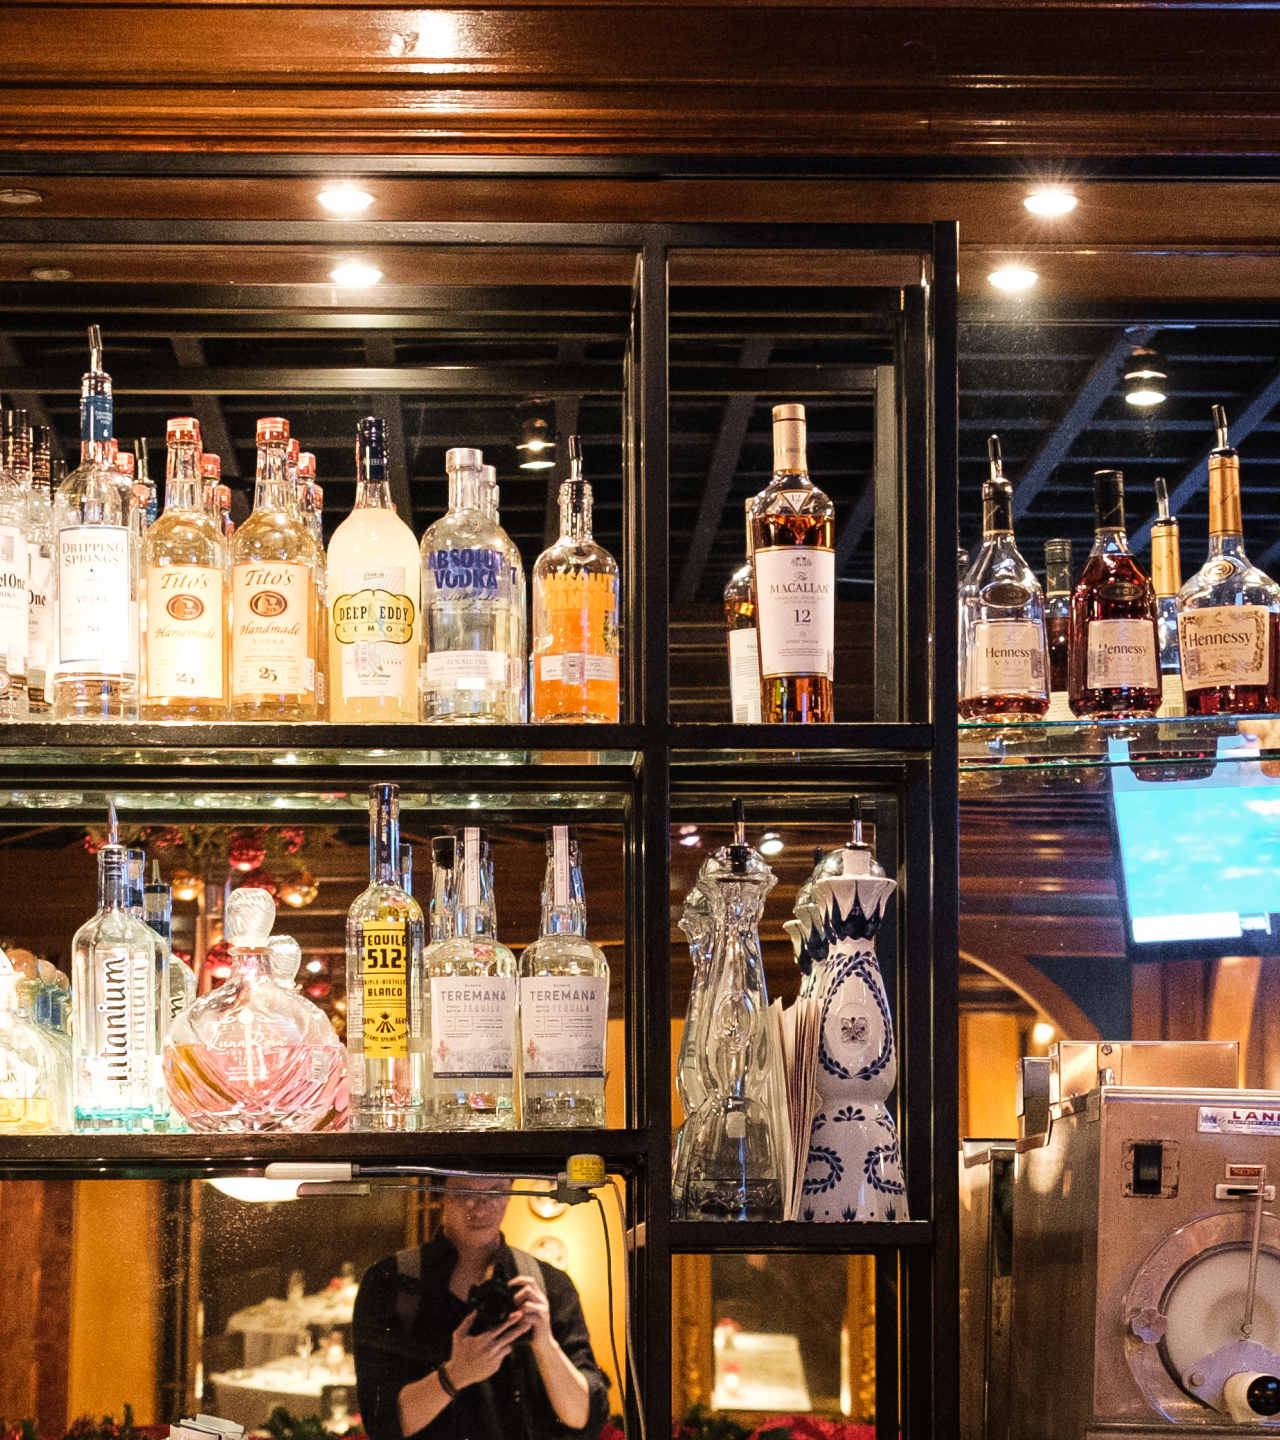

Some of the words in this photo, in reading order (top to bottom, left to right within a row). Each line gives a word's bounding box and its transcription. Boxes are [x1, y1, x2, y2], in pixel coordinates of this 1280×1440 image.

[65, 554, 119, 566] SPRINGS
[428, 549, 503, 570] ABSOLUT
[8, 578, 26, 590] One
[160, 573, 210, 590] Tito's
[244, 569, 295, 587] Tito's
[434, 568, 498, 589] VODKA
[770, 583, 830, 593] MACALLAN
[339, 607, 368, 621] DEEP
[379, 606, 409, 621] EDDY
[794, 609, 811, 623] 12
[239, 622, 301, 636] Handmade
[1186, 630, 1253, 648] Hennessy
[985, 646, 1033, 658] Henness
[1098, 643, 1147, 657] Hennessy
[258, 666, 278, 681] 25
[367, 948, 402, 969] 512
[367, 987, 403, 997] BLANCO
[440, 990, 508, 1001] TEREMANA
[530, 990, 596, 1001] TEREMANA
